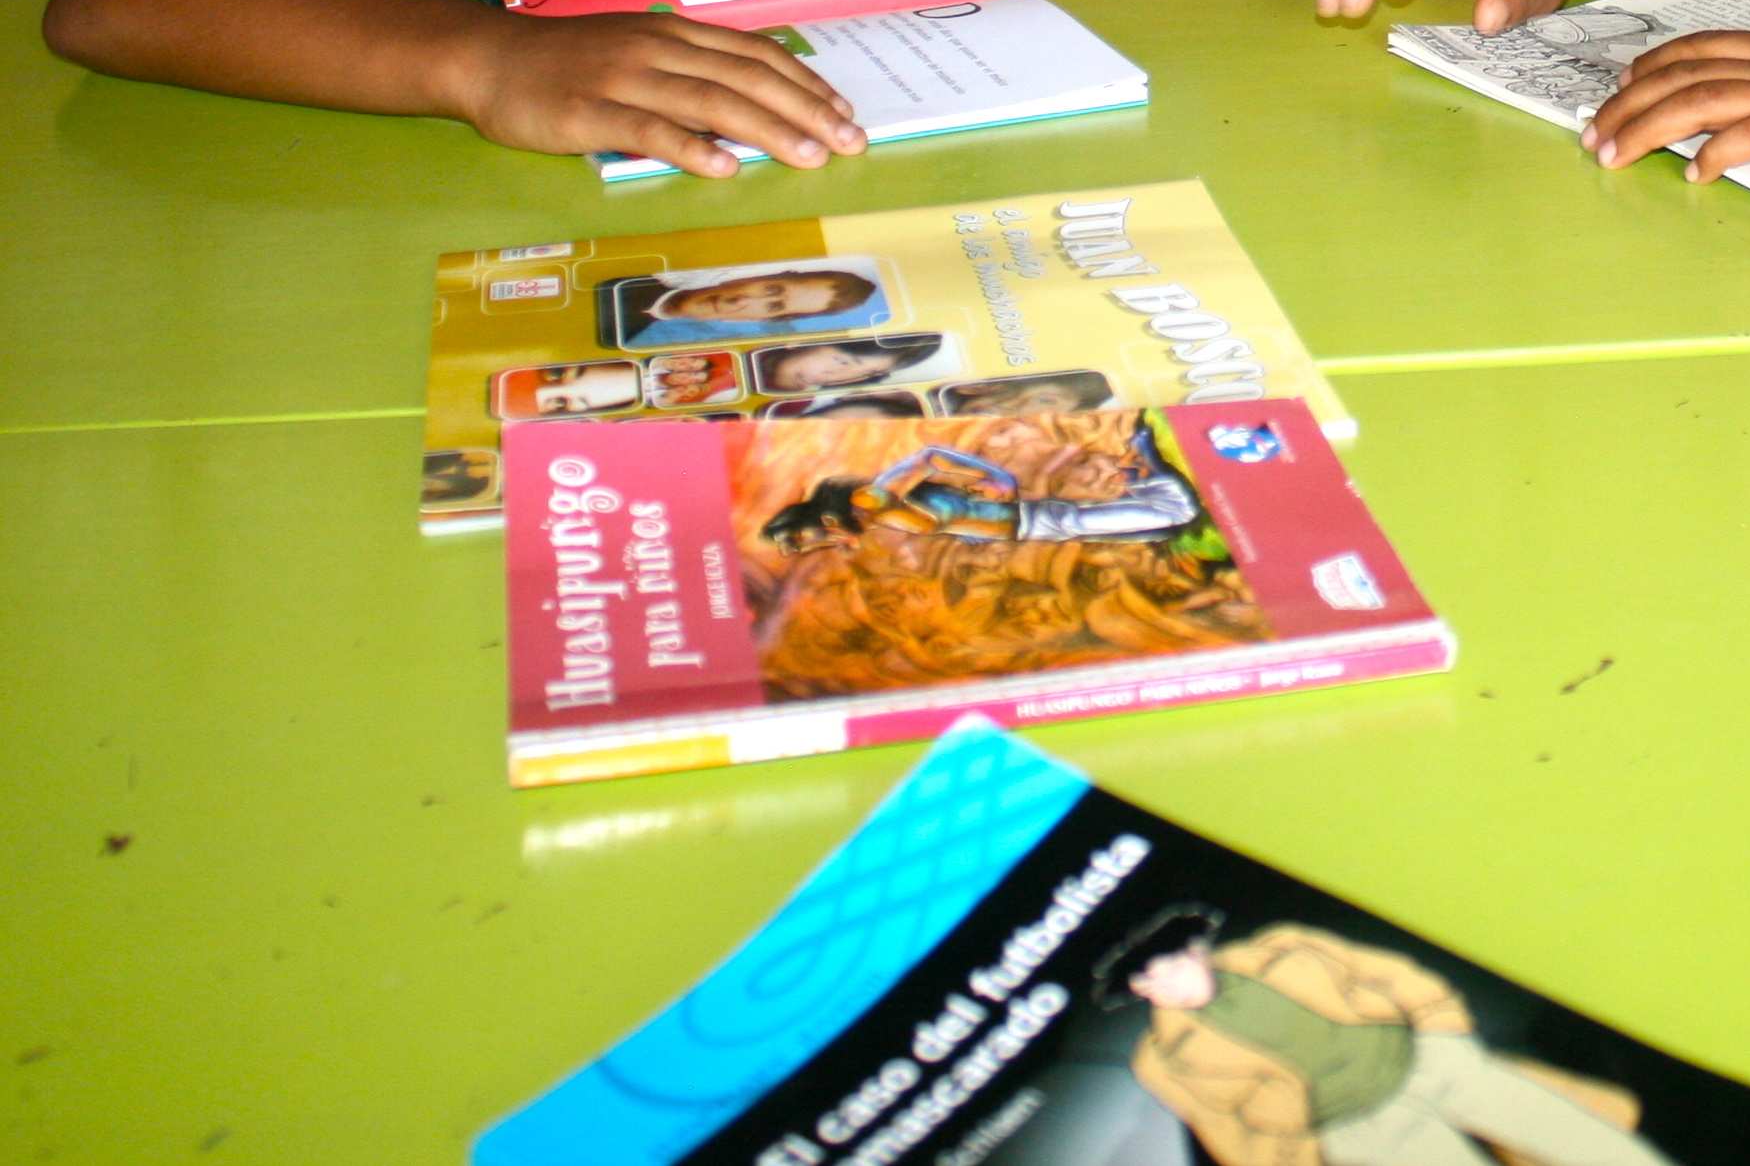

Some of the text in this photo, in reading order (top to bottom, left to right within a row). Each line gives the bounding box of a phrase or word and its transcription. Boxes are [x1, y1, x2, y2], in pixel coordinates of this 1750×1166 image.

[954, 213, 1037, 367] de los muchachos
[1002, 228, 1049, 279] amigo
[1058, 197, 1265, 405] JUAN BOSCO
[541, 455, 628, 712] Huasipungo
[645, 600, 704, 668] para
[816, 1057, 921, 1145] caso
[912, 992, 988, 1063] del
[968, 833, 1154, 1003] futbolista
[834, 981, 1071, 1166] mascarado
